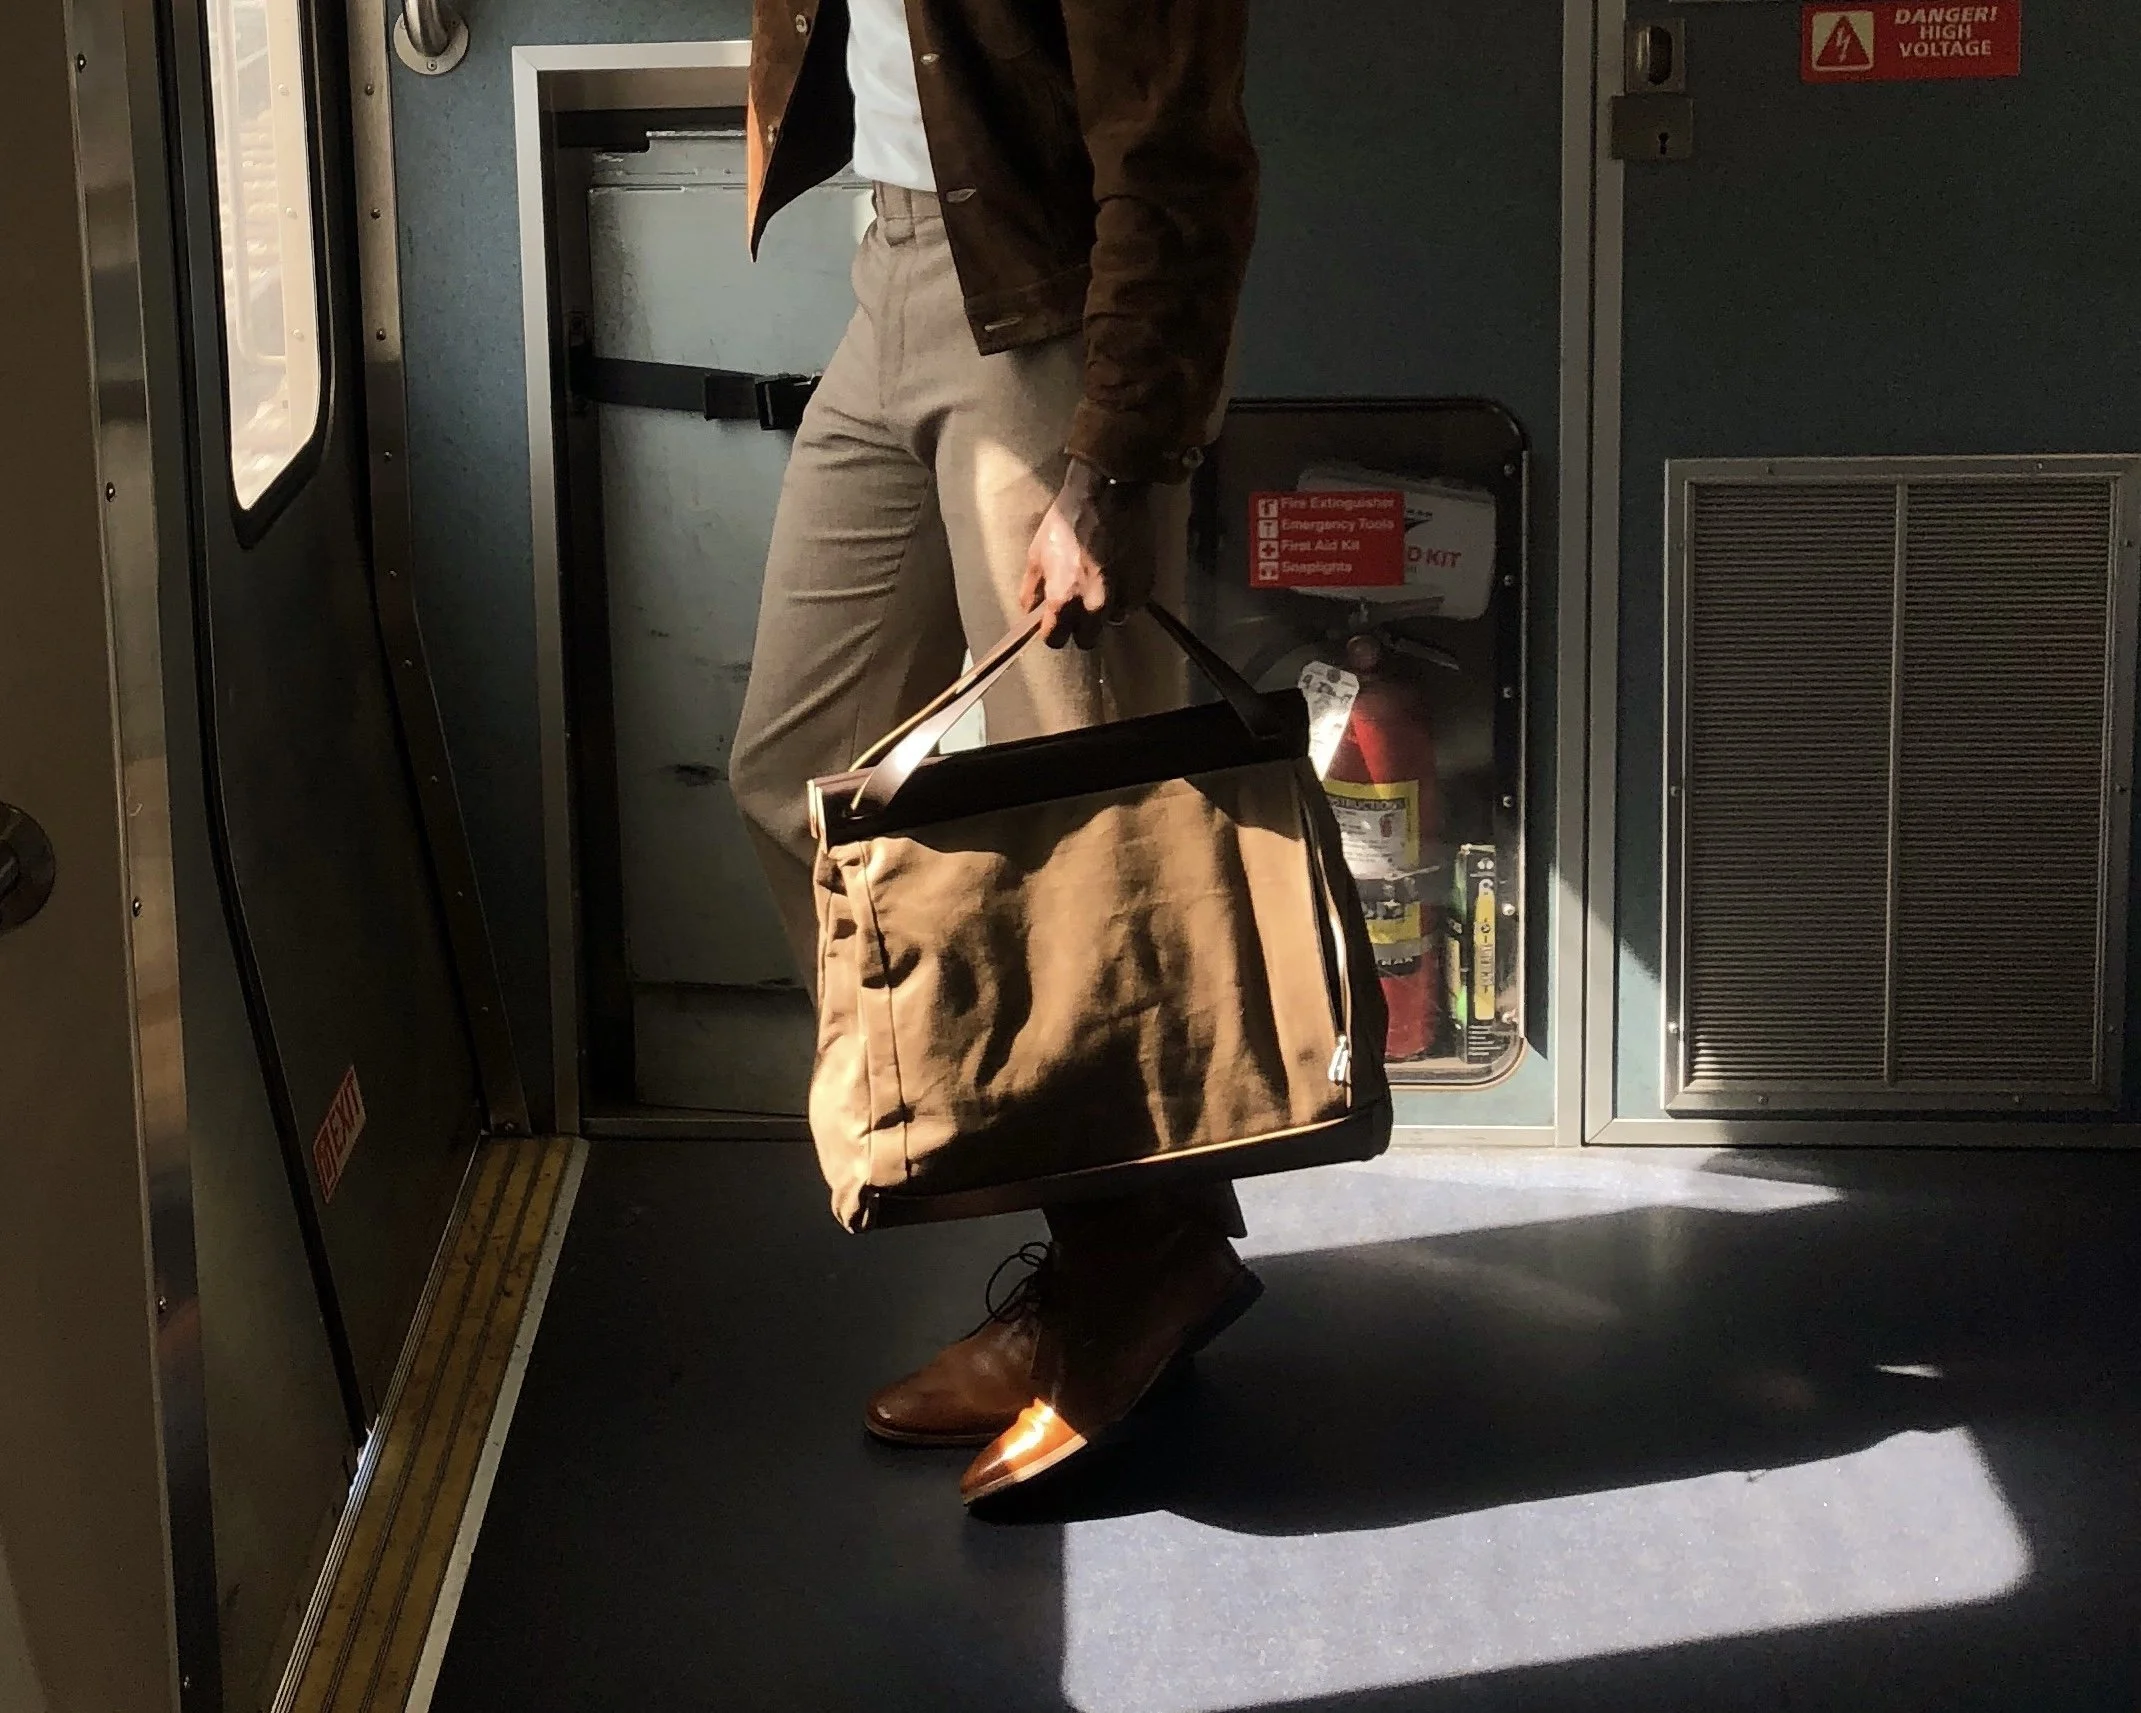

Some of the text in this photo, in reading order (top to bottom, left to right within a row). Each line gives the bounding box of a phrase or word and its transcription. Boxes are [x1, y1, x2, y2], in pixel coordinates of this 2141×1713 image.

[1895, 6, 1998, 24] DANGER!
[1920, 24, 1971, 40] HIGH
[1899, 40, 1991, 57] VOLTAGE
[1281, 497, 1395, 511] Fire Extinguisher
[1282, 517, 1395, 532] Emergency Tools
[1281, 539, 1360, 550] First Aid Kit
[1426, 548, 1462, 568] KIT
[328, 1070, 360, 1159] EXIT
